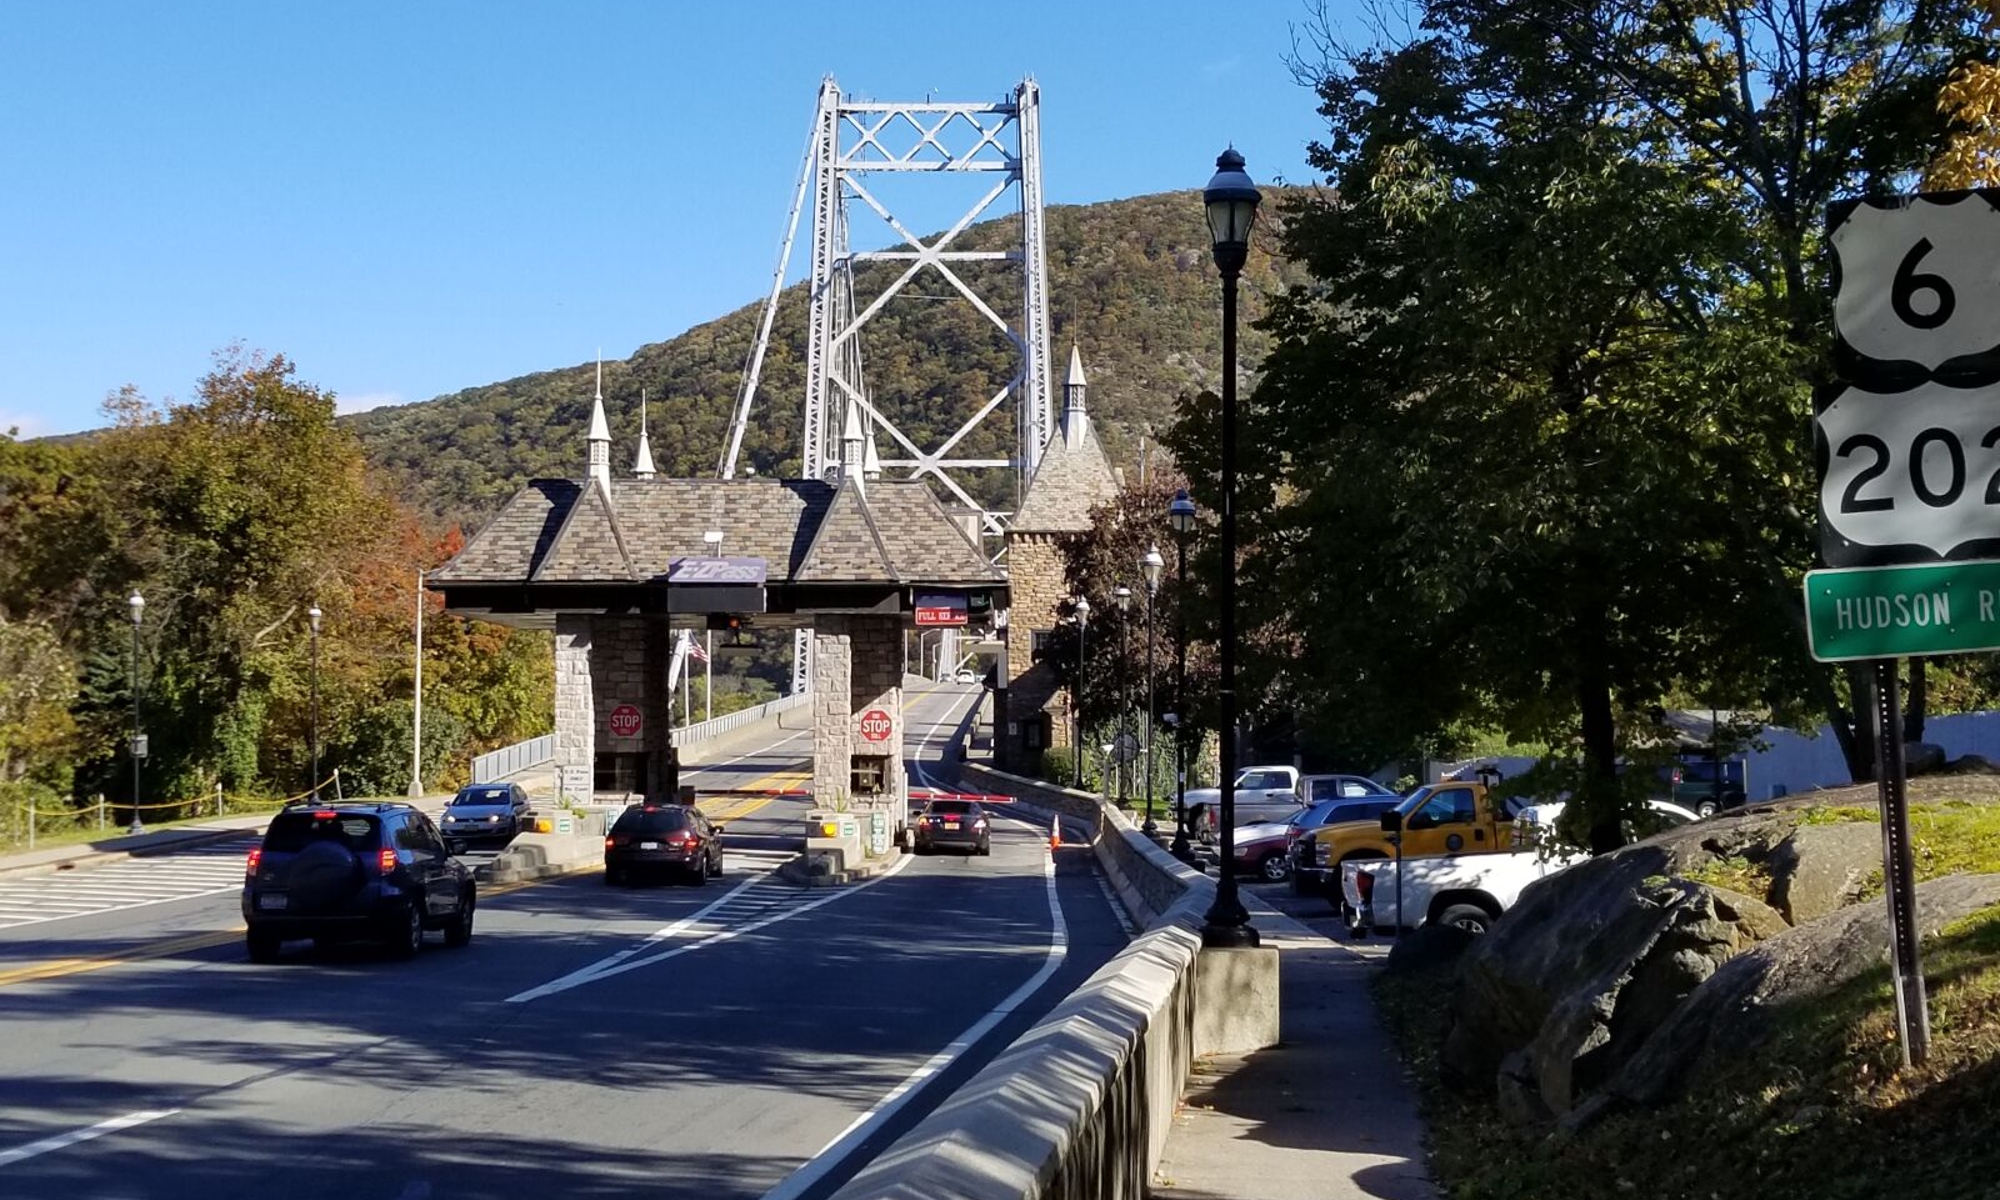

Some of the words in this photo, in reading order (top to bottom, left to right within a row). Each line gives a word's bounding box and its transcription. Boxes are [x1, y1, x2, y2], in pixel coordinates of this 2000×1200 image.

[1891, 236, 1956, 330] 6
[1836, 591, 1951, 630] HUDSON
[1979, 589, 2000, 623] R
[612, 715, 640, 728] STOP
[862, 719, 890, 733] STOP
